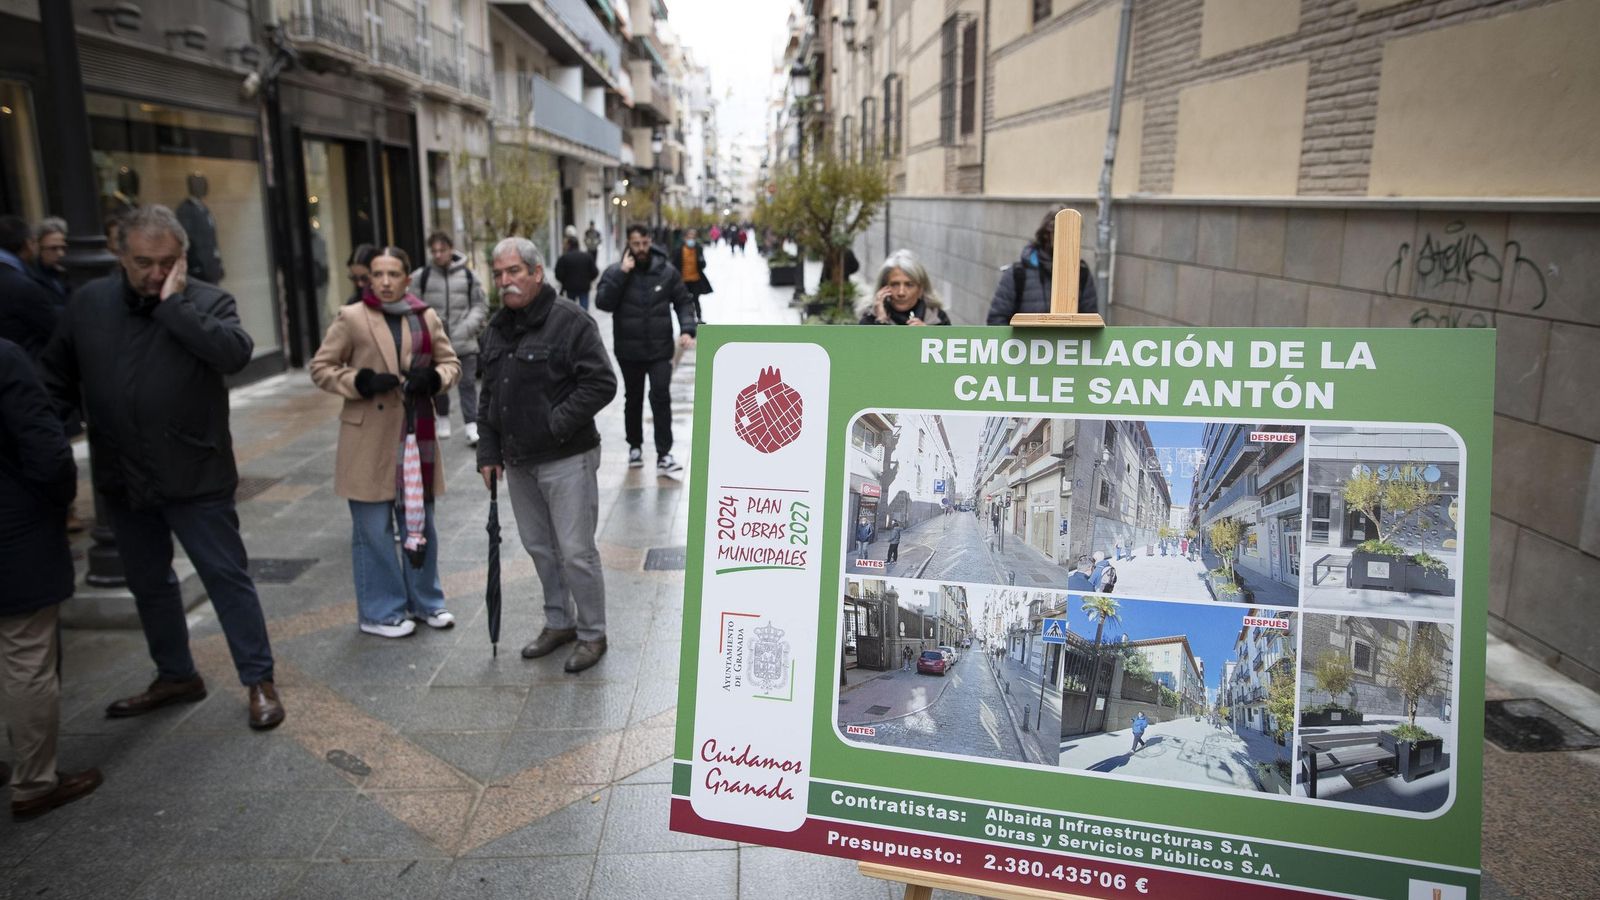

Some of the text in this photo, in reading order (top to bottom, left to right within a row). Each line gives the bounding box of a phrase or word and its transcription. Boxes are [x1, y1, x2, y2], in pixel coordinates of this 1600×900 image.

[920, 334, 1377, 370] REMODELACIÓN DE LA
[953, 374, 1335, 410] CALLE SAN ANTÓN
[1252, 433, 1295, 443] DESPUÉS
[717, 496, 739, 540] 2024
[747, 496, 782, 514] PLAN
[741, 522, 786, 539] OBRAS
[789, 501, 810, 545] 2027
[718, 545, 807, 566] MUNICIPALES
[1245, 617, 1288, 628] DESPUÉS
[848, 726, 873, 735] ANTES
[701, 738, 802, 774] Cuidamos
[705, 767, 794, 800] Granada
[830, 790, 967, 823] Contratistas:
[827, 831, 962, 864] Presupuesto:
[985, 807, 1260, 858] Albaida Infraestructuras S.A.
[984, 823, 1281, 878] Obras y Servicios Públicos S.A.
[983, 853, 1149, 894] 2.380.435'06 €
